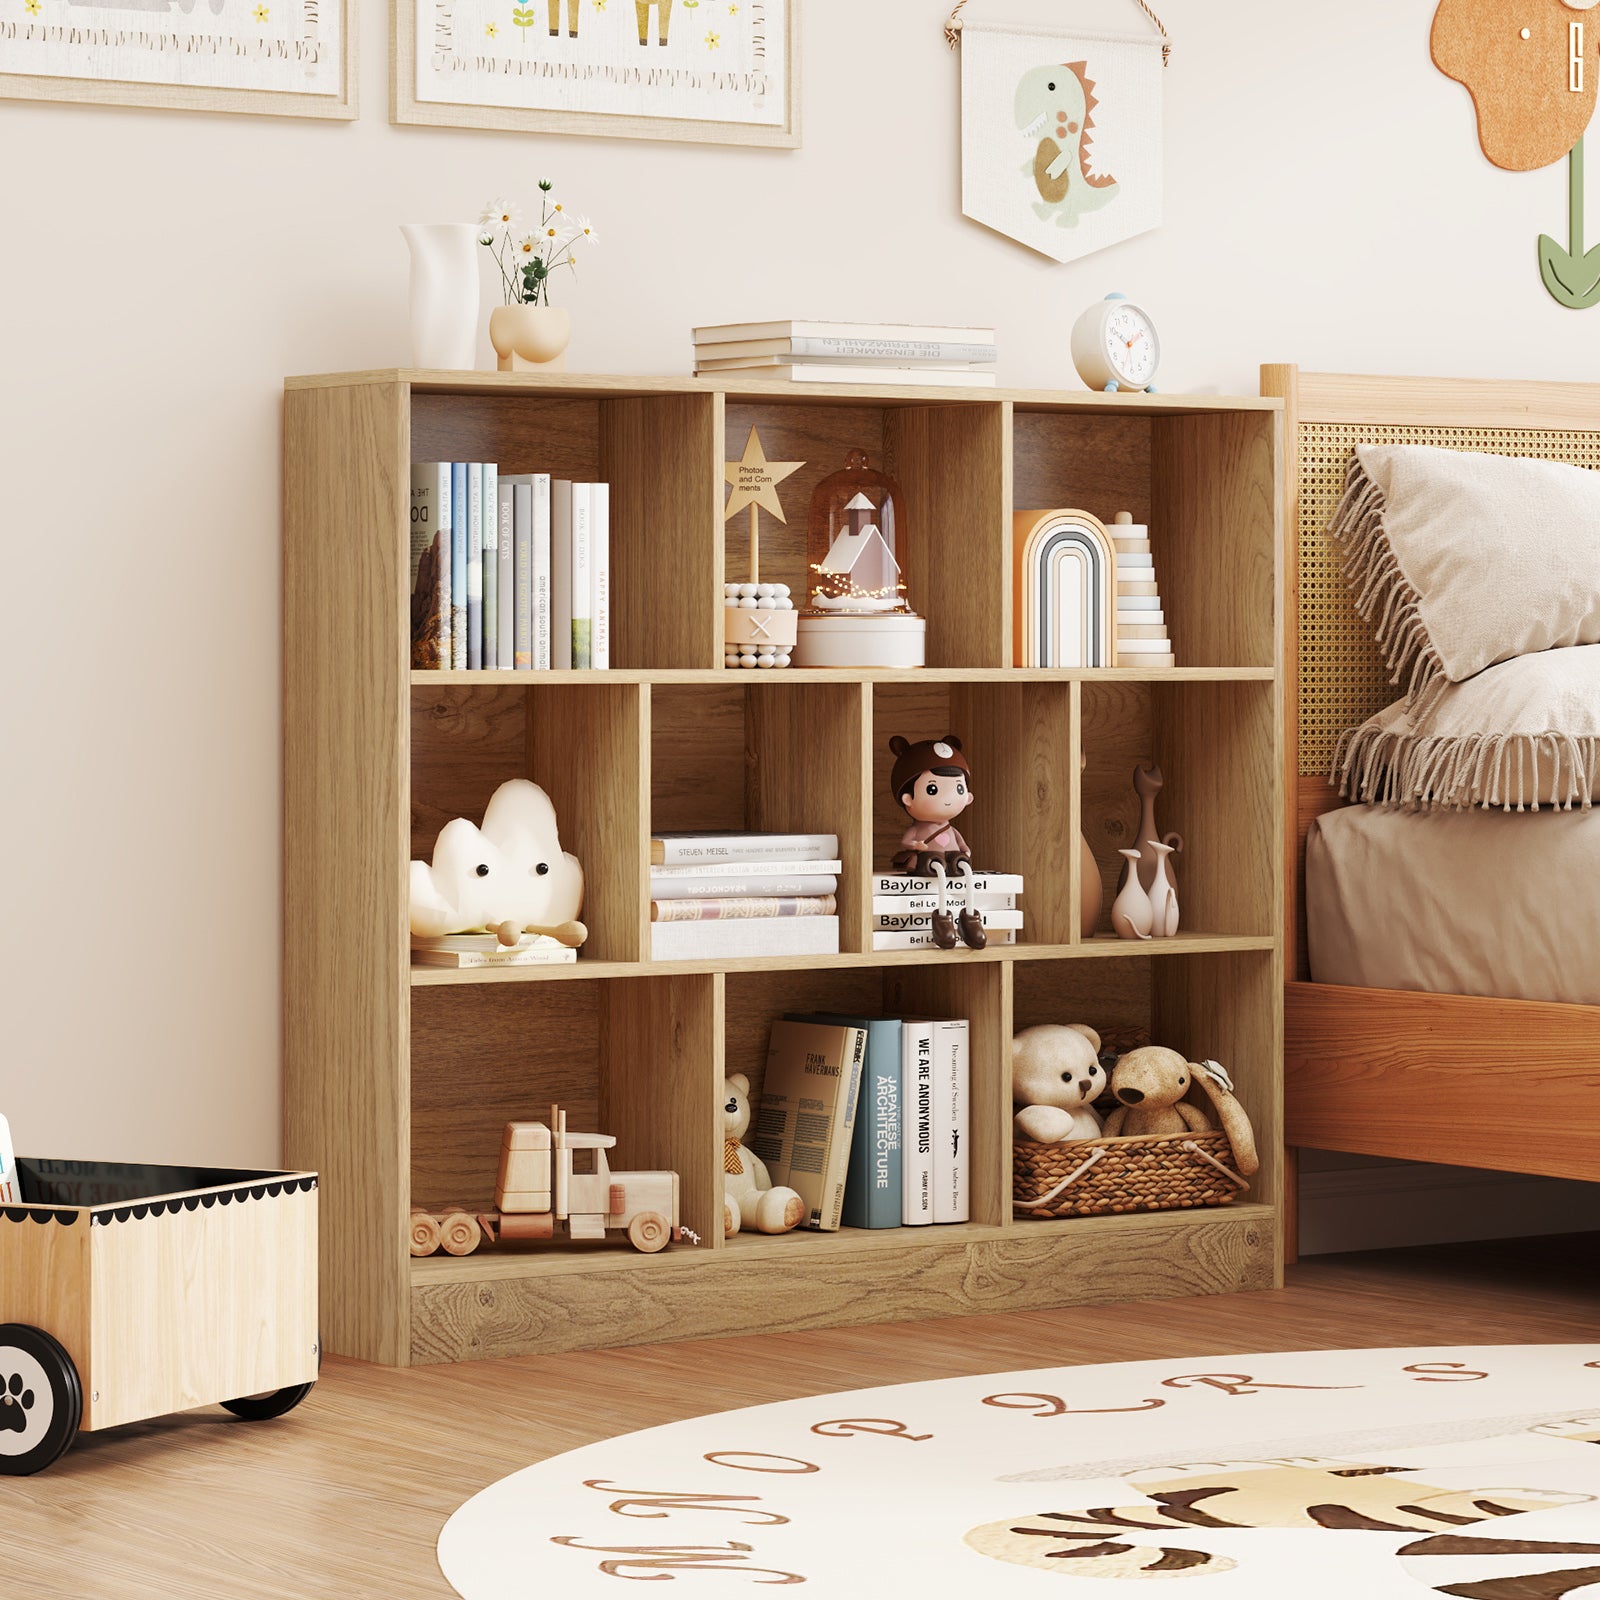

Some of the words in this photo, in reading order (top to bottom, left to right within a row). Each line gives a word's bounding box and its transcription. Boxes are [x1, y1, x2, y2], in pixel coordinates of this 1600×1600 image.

[836, 346, 916, 357] EINSAMKEIT
[919, 350, 941, 358] DIE
[739, 466, 764, 474] Photos
[739, 475, 753, 483] and
[502, 502, 510, 524] BOOK
[502, 527, 510, 538] OF
[502, 540, 510, 560] CATS
[678, 848, 704, 857] STEVEN
[706, 848, 729, 856] MEISEL
[880, 879, 931, 893] Baylor
[946, 880, 987, 890] Moel
[910, 900, 924, 908] Bel
[880, 914, 931, 928] Baylor
[919, 1038, 929, 1056] WE
[806, 1053, 826, 1065] FRANK
[951, 1044, 959, 1081] Dreaming
[919, 1059, 929, 1080] ARE
[888, 1076, 897, 1150] JAPANESE
[919, 1083, 929, 1154] ANONYMOUS
[877, 1075, 888, 1189] ARCHITECTURE
[703, 1451, 820, 1474] O
[810, 1418, 934, 1441] P
[1161, 1373, 1367, 1395] R
[1402, 1363, 1489, 1382] S
